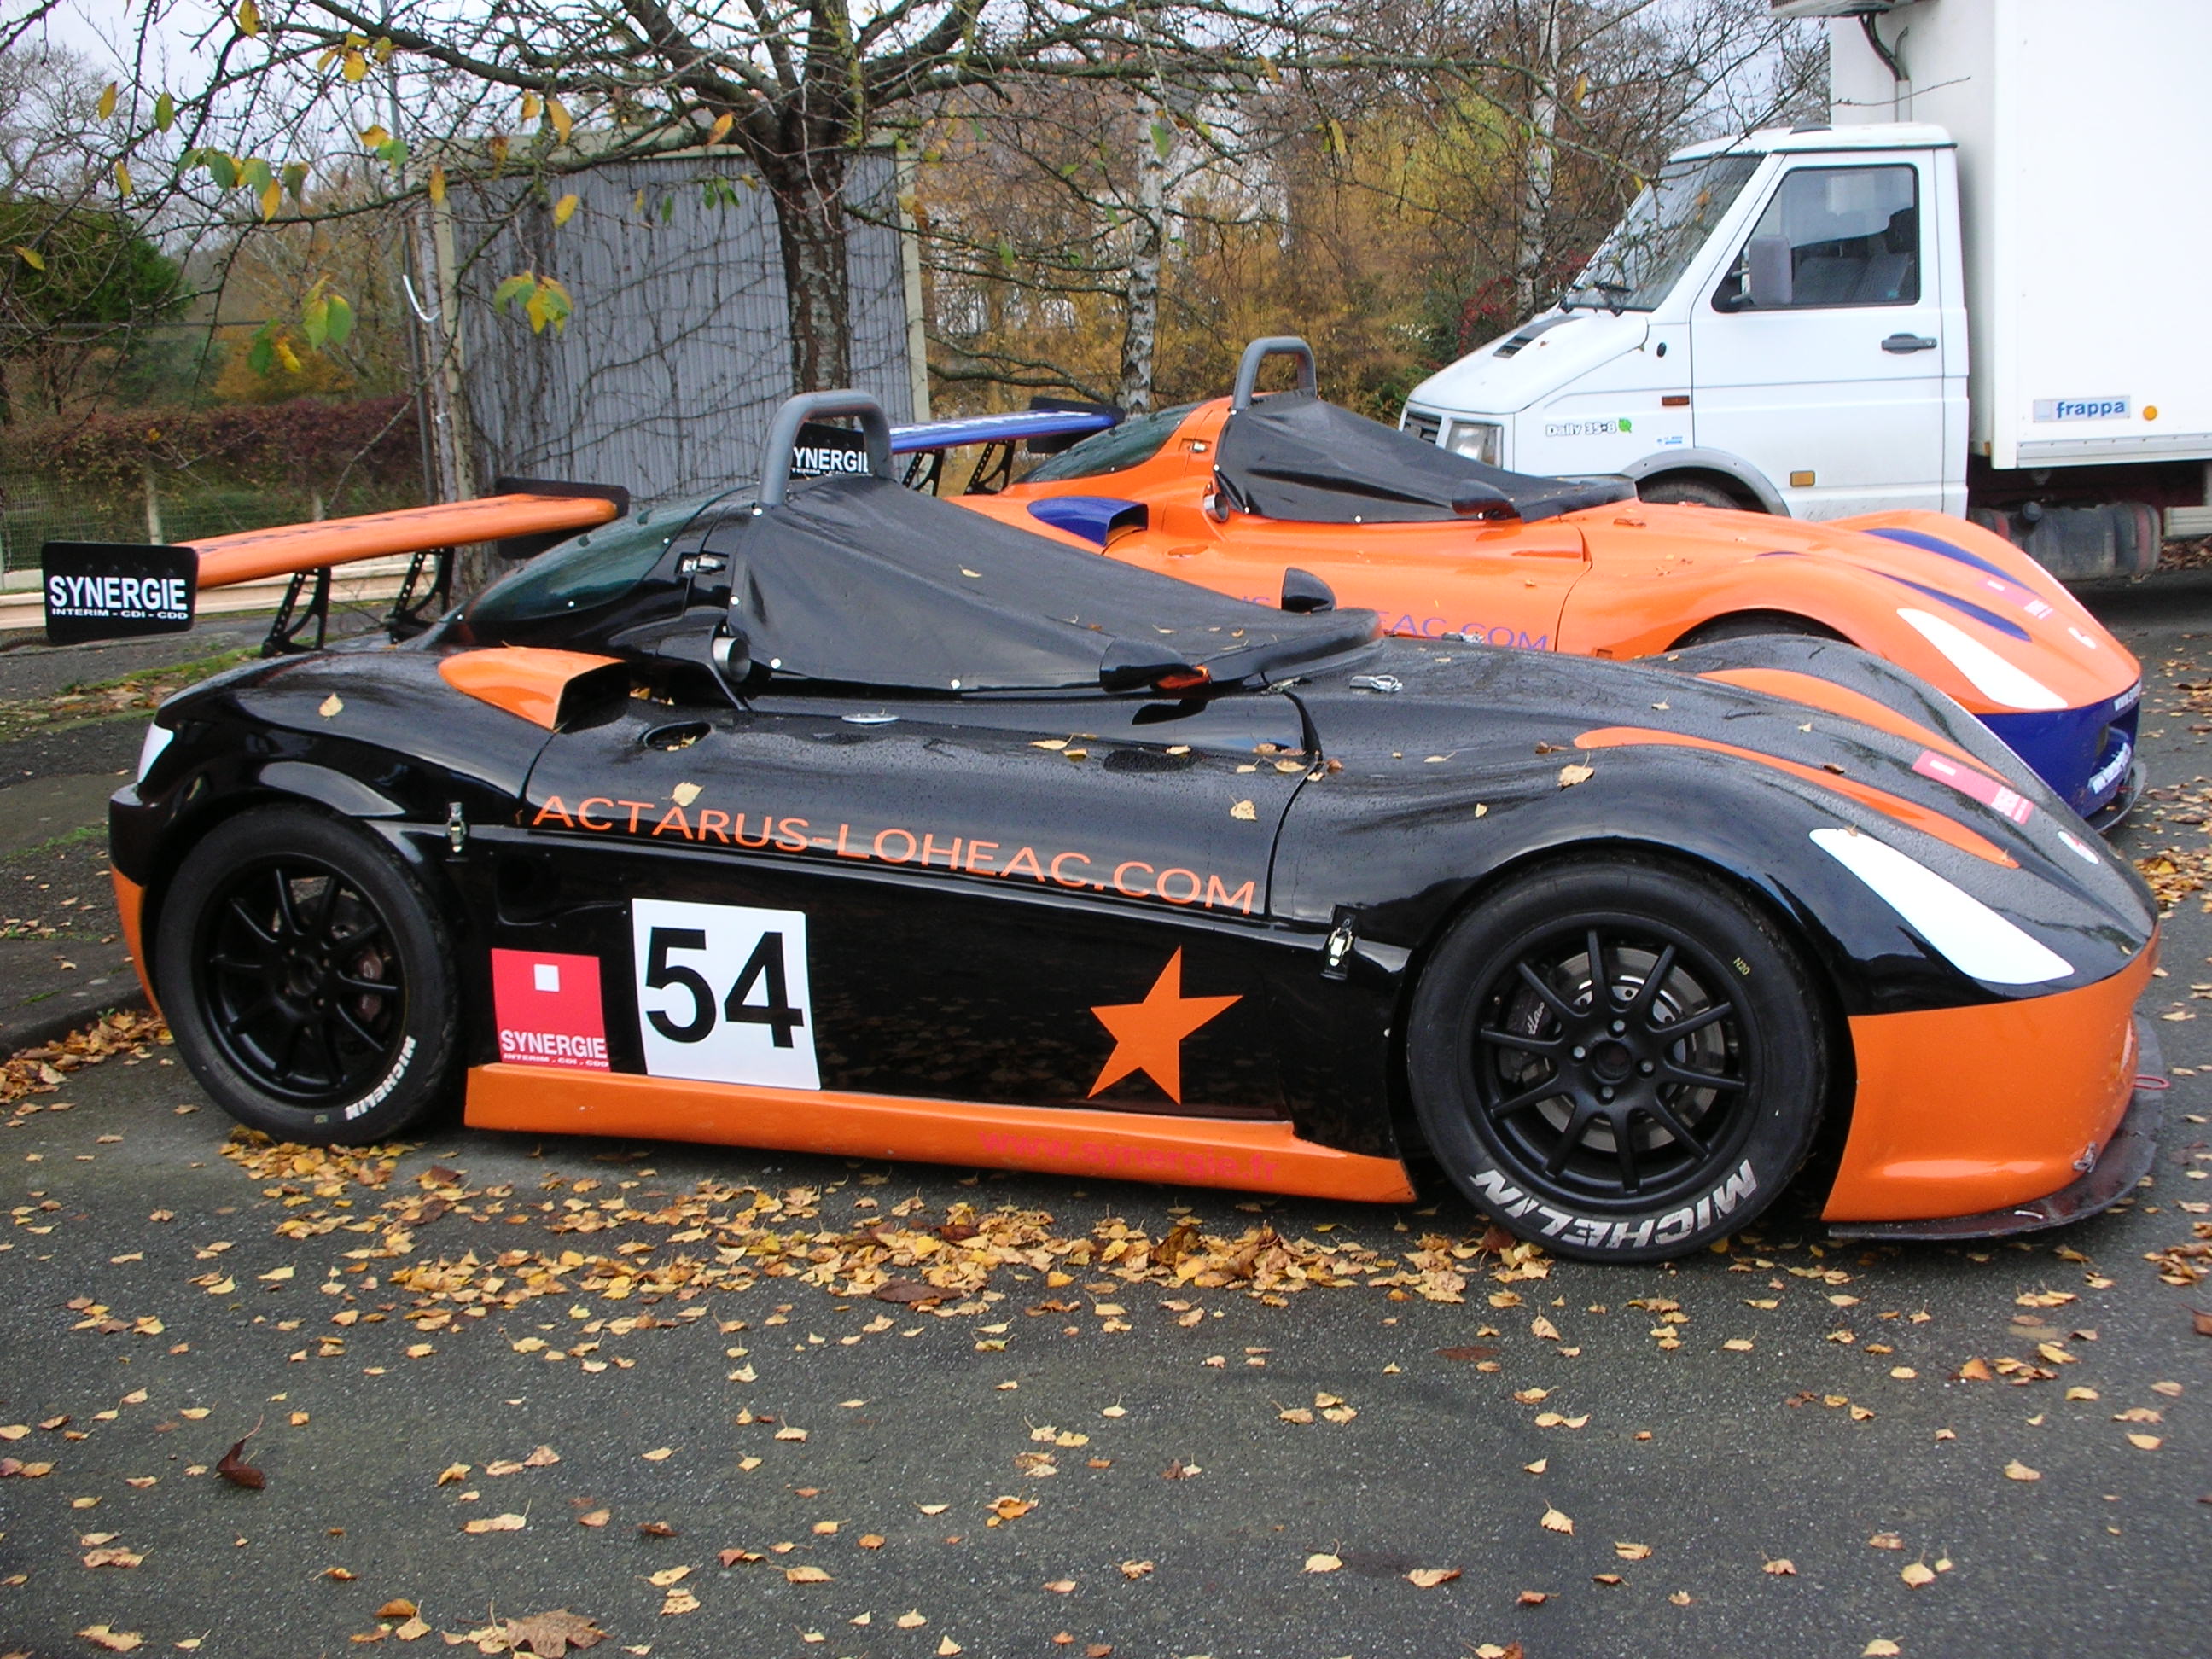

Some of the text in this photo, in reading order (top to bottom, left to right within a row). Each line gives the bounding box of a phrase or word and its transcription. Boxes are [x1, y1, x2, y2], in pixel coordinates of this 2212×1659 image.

[2056, 400, 2125, 419] frappa
[49, 574, 188, 611] SYNERGIE
[52, 608, 109, 617] INTERIM
[121, 609, 146, 619] CDI
[157, 611, 189, 620] CDD
[532, 795, 1256, 915] ACTARUS-LOHEAC.COM
[645, 926, 805, 1049] 54
[500, 1029, 608, 1059] SYNERGIE
[504, 1052, 550, 1062] INTERIM
[345, 1035, 416, 1121] MICHELIN
[978, 1131, 1279, 1183] www.synergie.fr
[1469, 1159, 1758, 1249] MICHELIN
